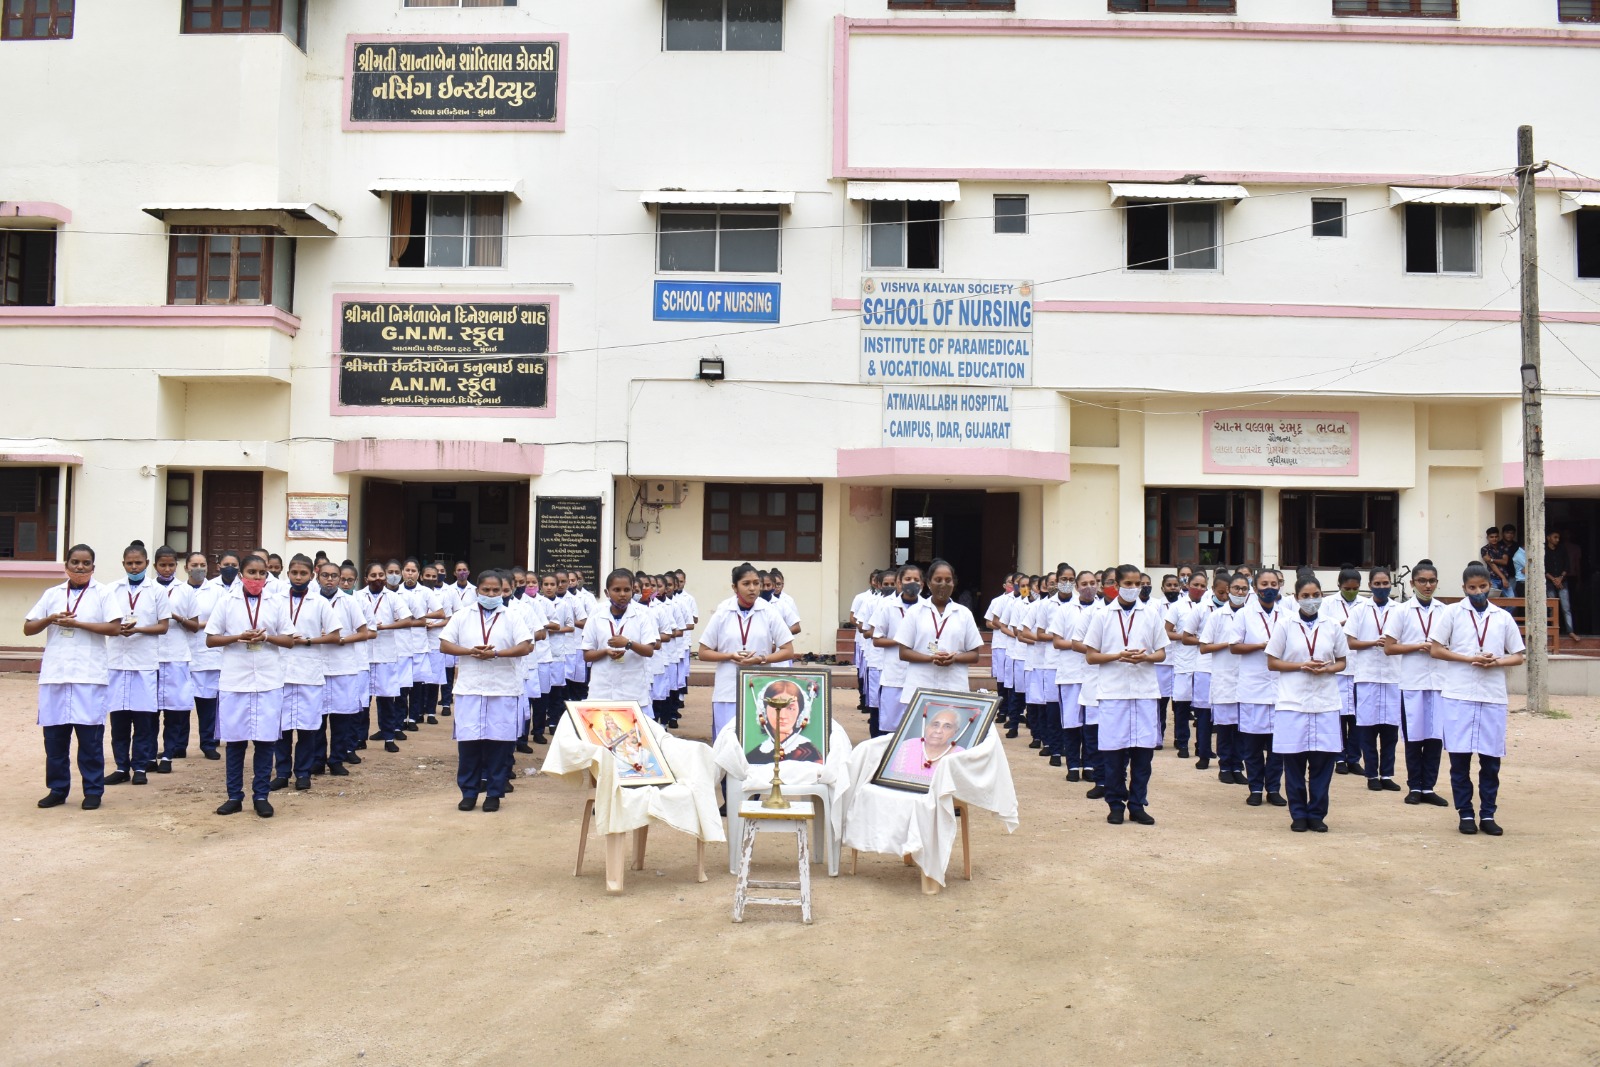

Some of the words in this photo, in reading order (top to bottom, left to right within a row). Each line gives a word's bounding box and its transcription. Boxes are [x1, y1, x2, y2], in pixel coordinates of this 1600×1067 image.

[357, 47, 396, 71] શ્રીમતી
[400, 46, 455, 71] શાન્તાબેન
[459, 46, 512, 71] શાંતિલાલ
[516, 46, 554, 71] કોઠારી
[438, 74, 536, 106] ઈન્સ્ટીટ્યુટ
[881, 282, 920, 292] VISHVA
[924, 283, 964, 293] KALYAN
[968, 284, 1013, 294] SOCIETY
[662, 290, 704, 311] SCHOOL
[707, 291, 722, 312] OF
[724, 292, 772, 313] NURSING
[345, 305, 384, 323] શ્રીમતી
[389, 305, 450, 324] નિર્મળાબેન
[455, 306, 517, 324] દિનેશભાઈ
[520, 310, 546, 326] શાહ
[863, 298, 927, 325] SCHOOL
[933, 299, 954, 325] OF
[959, 300, 1031, 327] NURSING
[382, 326, 453, 341] G.N.M.
[460, 326, 504, 346] સ્કૂલ
[864, 337, 925, 353] INSTITUTE
[929, 338, 944, 354] OF
[948, 339, 1029, 356] PARAMEDICAL
[344, 358, 388, 372] શ્રીમતી
[463, 360, 513, 377] કનુભાઈ
[517, 363, 544, 375] શાહ
[868, 360, 876, 376] &
[880, 360, 954, 377] VOCATIONAL
[958, 362, 1024, 378] EDUCATION
[390, 378, 451, 391] A.N.M.
[457, 378, 496, 397] સ્કૂલ
[887, 393, 957, 411] ATMAVALLABH
[961, 395, 1008, 411] HOSPITAL
[890, 421, 933, 441] CAMPUS,
[937, 421, 962, 442] IDAR,
[965, 422, 1010, 439] GUJARAT
[1214, 422, 1242, 432] આત્મ
[1245, 423, 1274, 432] વલ્લભ
[1279, 423, 1303, 437] સમુદ્ર
[1316, 424, 1345, 434] ભવન
